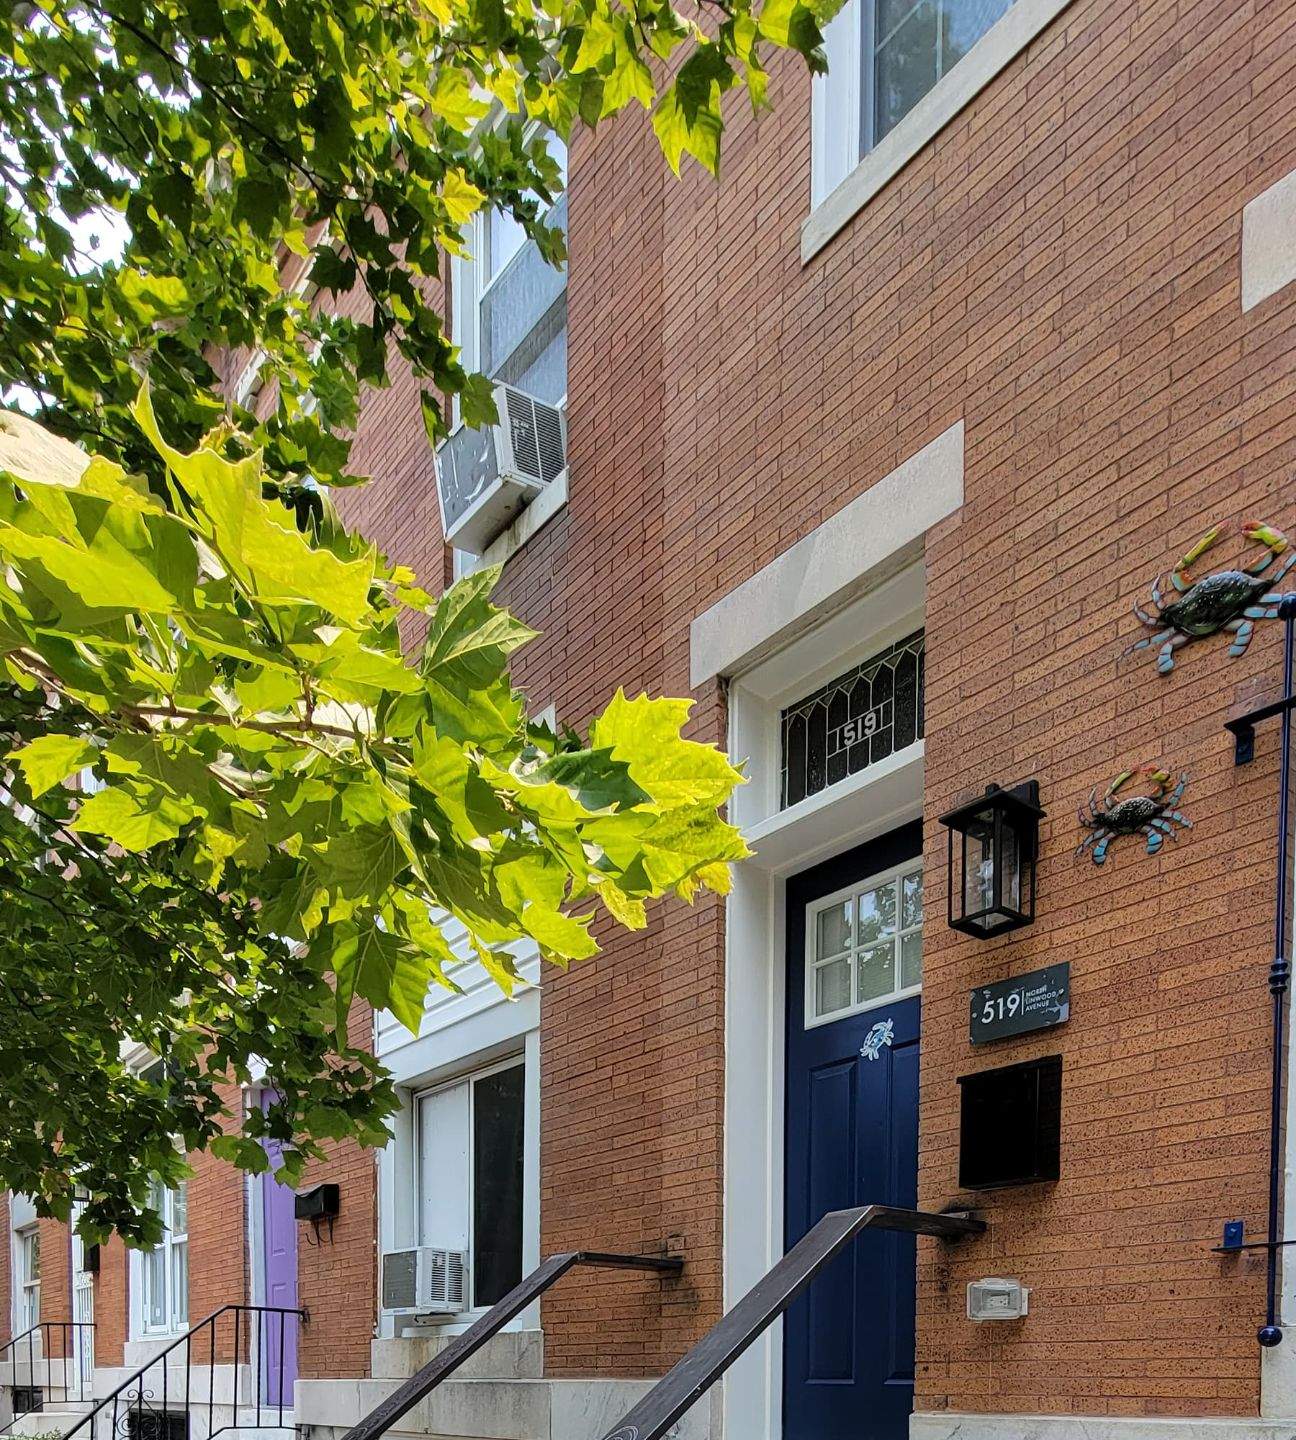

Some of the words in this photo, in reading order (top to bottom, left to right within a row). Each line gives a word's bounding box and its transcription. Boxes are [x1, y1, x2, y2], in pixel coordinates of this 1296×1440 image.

[843, 712, 877, 746] 519
[1026, 991, 1056, 1004] LINWOOD
[1026, 1000, 1049, 1011] AVENUE
[981, 994, 1020, 1024] 519
